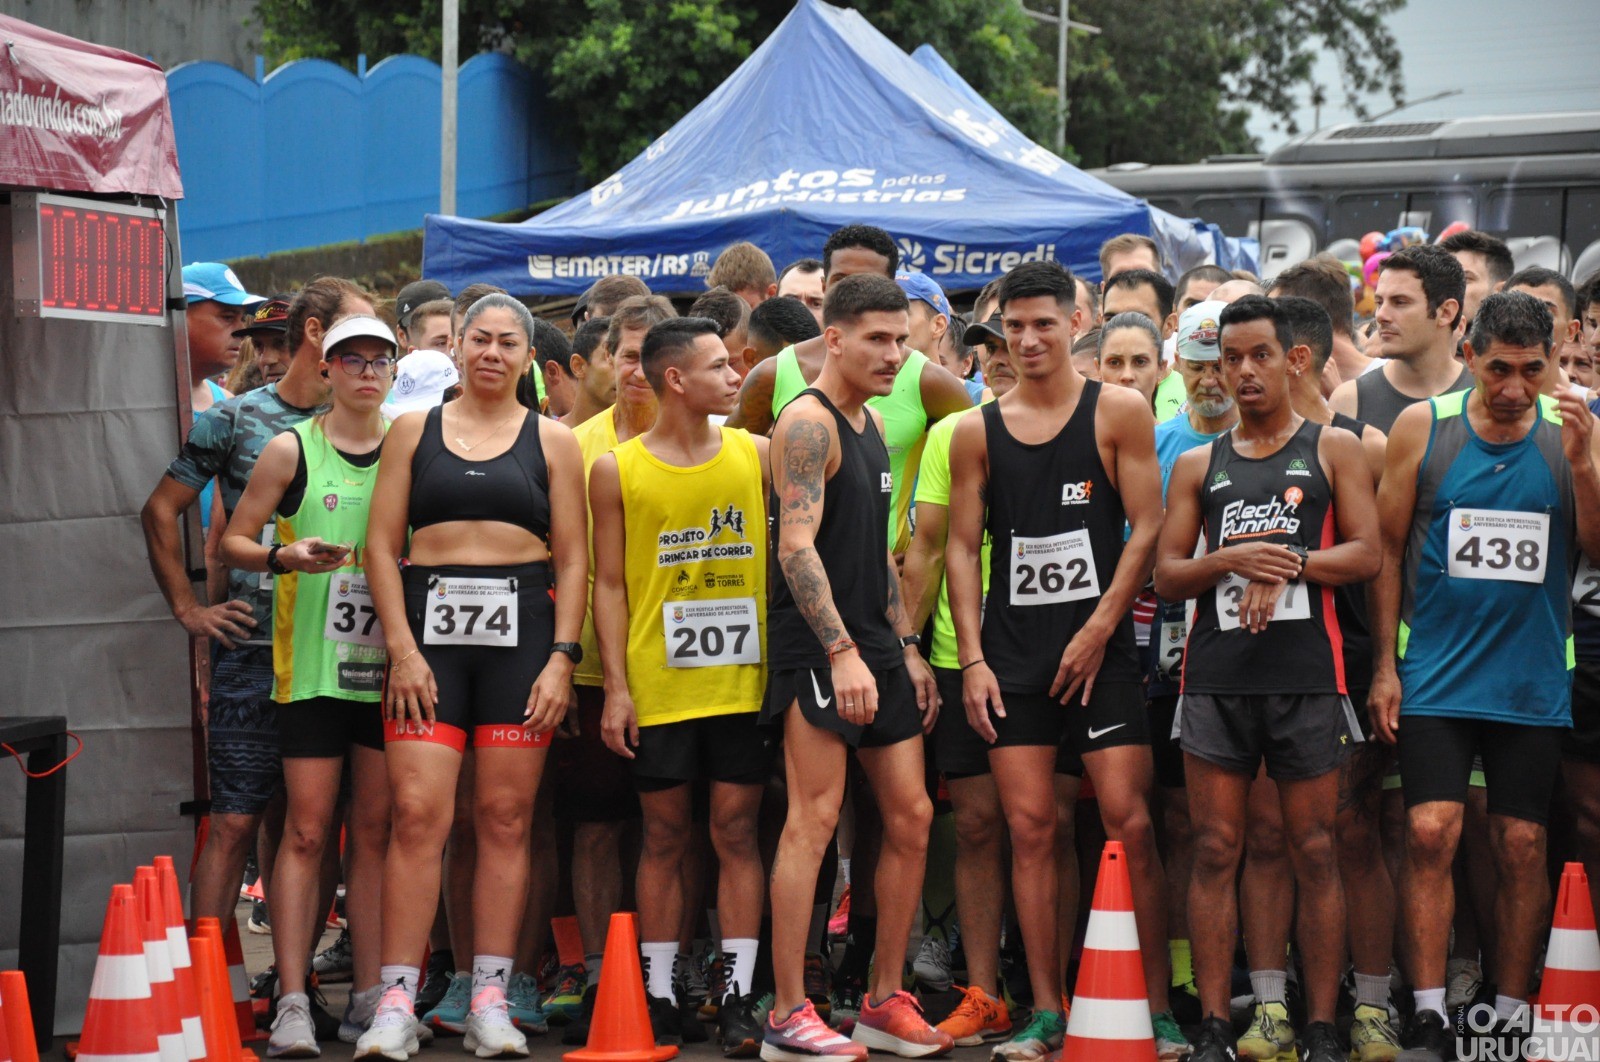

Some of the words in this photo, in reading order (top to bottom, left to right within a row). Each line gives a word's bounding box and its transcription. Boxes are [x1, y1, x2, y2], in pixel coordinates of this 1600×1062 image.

[881, 174, 947, 189] pelas
[554, 253, 689, 278] EMATER/RS
[932, 244, 1056, 275] Sicredi
[659, 530, 705, 546] PROJETO
[659, 550, 699, 564] BRINCAR
[702, 548, 712, 558] DE
[714, 545, 752, 557] CORRER
[1456, 536, 1540, 571] 438
[717, 579, 745, 587] TORRES
[1016, 558, 1091, 595] 262
[333, 602, 378, 636] 37
[432, 604, 511, 636] 374
[672, 624, 750, 658] 207
[342, 669, 373, 678] Unimed
[492, 729, 541, 742] MORE
